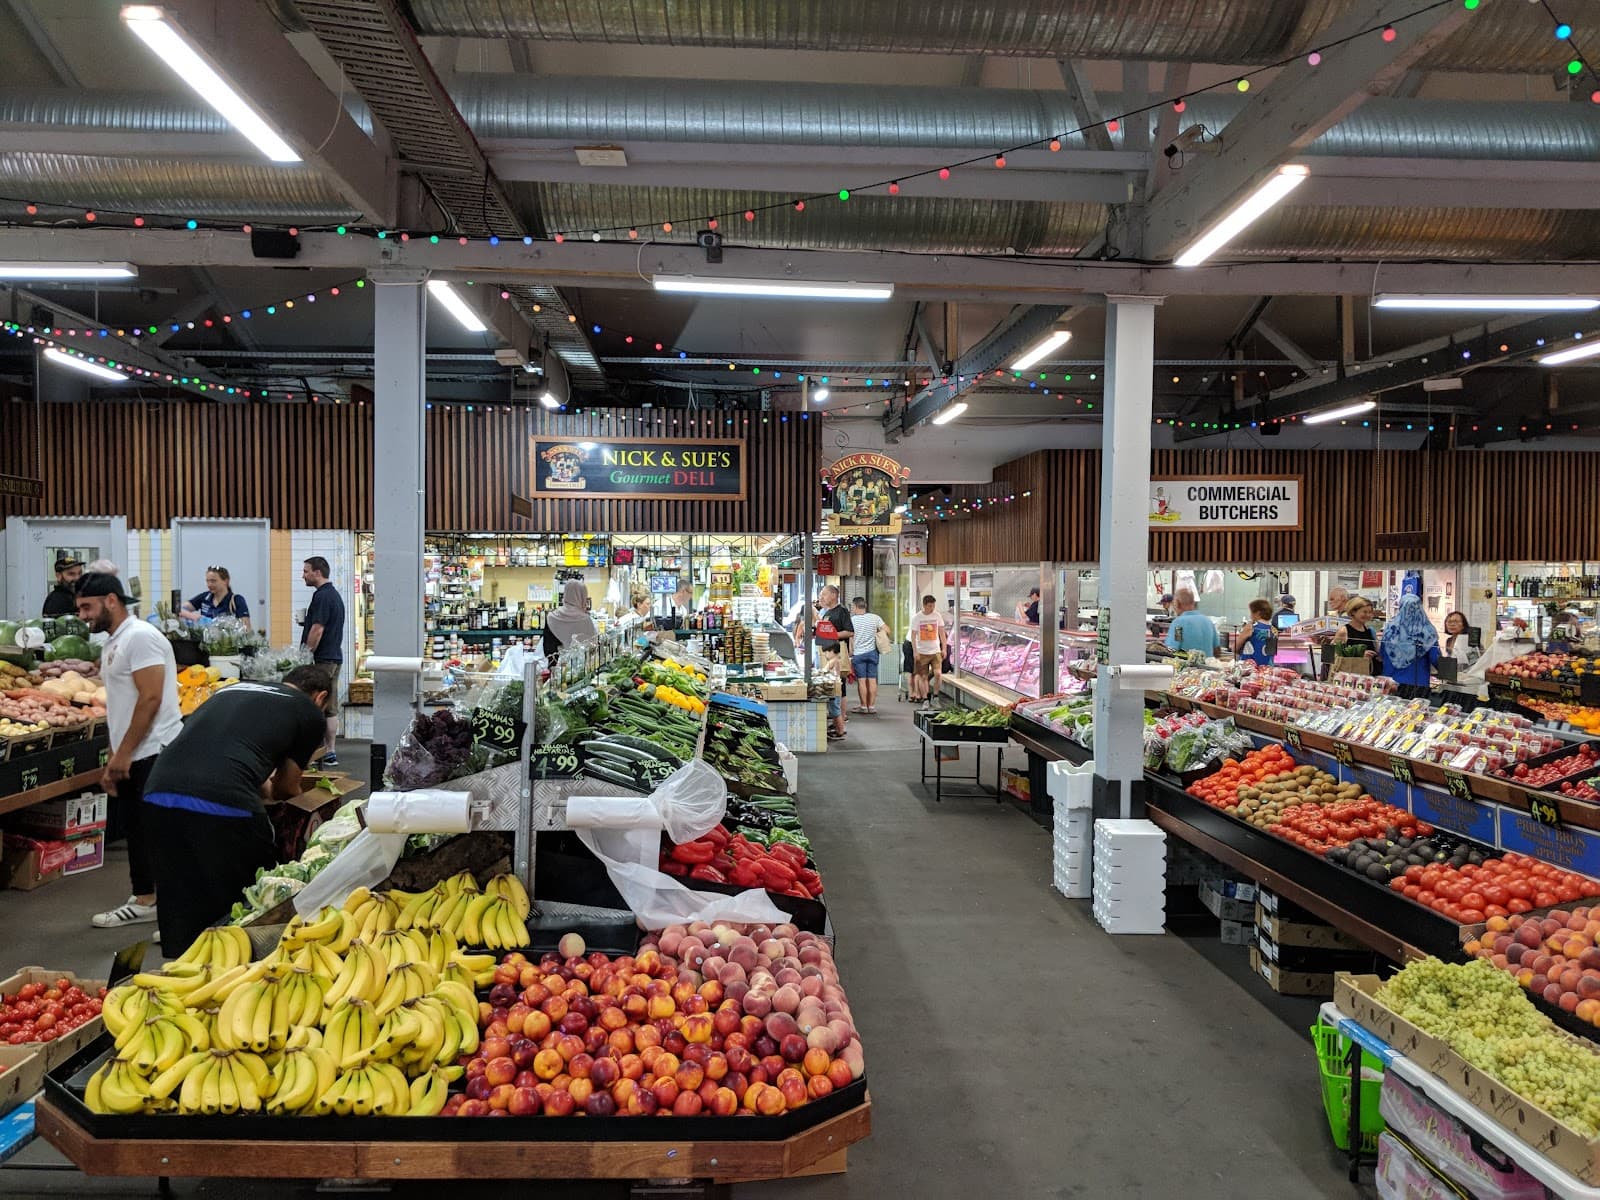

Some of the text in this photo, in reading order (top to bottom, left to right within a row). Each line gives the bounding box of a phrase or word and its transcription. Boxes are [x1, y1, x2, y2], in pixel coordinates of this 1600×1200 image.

[603, 450, 657, 466] NICK
[661, 451, 677, 467] &
[681, 451, 731, 468] SUE'S
[832, 455, 900, 475] NICK & SUE'S
[609, 470, 715, 486] Gourmet DELI
[1187, 486, 1291, 501] COMMERCIAL
[1199, 505, 1278, 520] BUTCHERS
[867, 525, 891, 533] DELI
[477, 708, 514, 726] BANANAS
